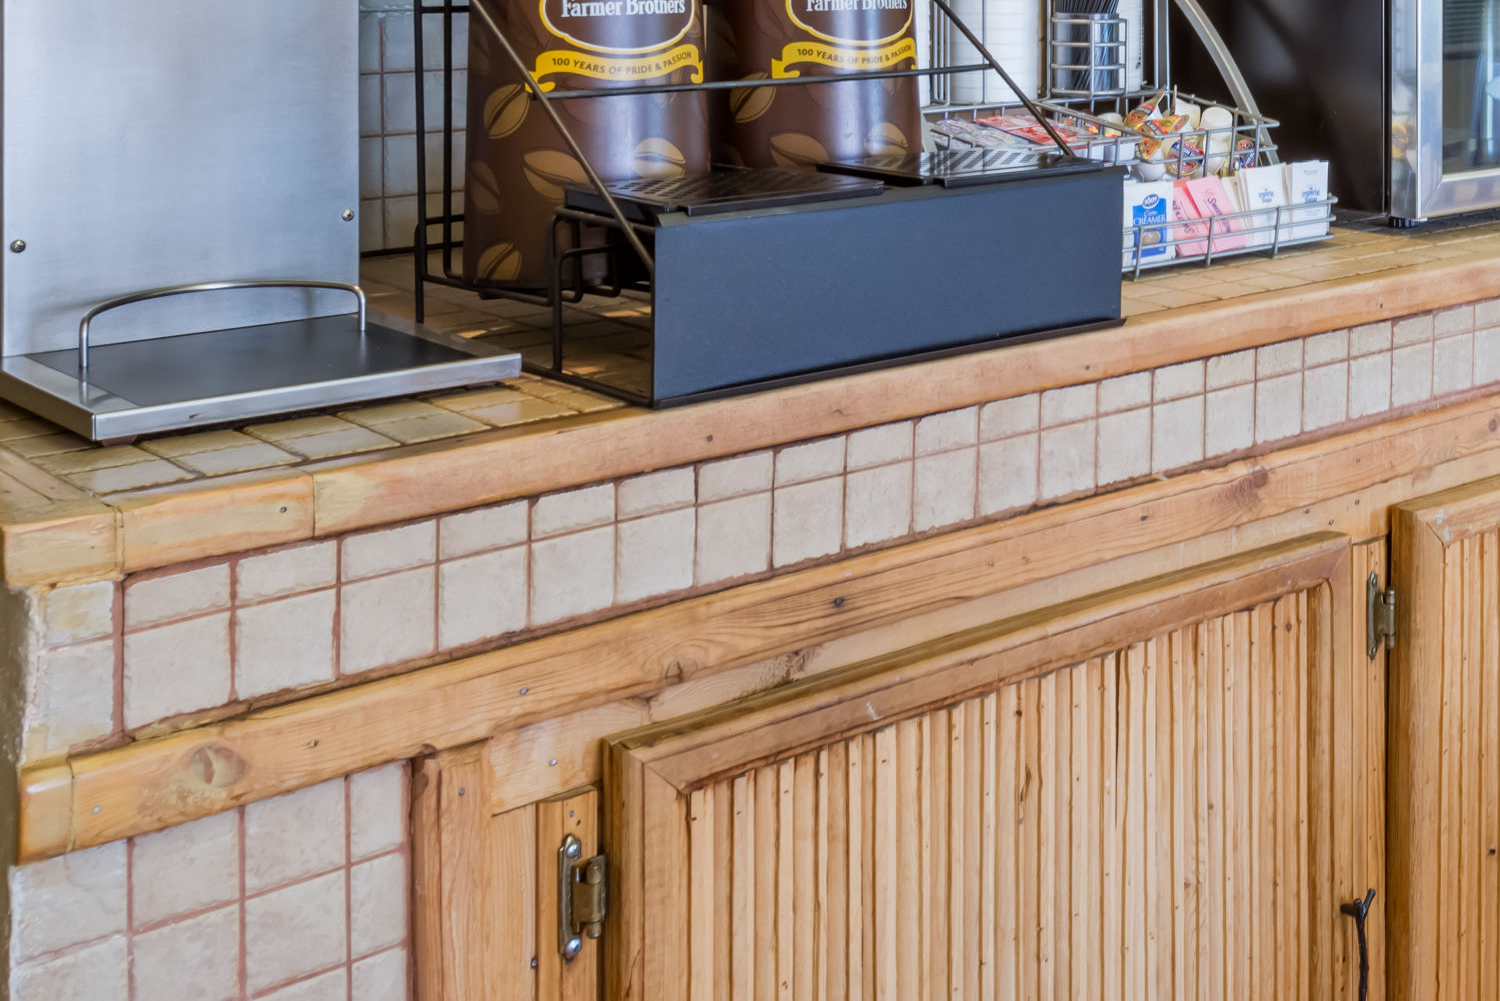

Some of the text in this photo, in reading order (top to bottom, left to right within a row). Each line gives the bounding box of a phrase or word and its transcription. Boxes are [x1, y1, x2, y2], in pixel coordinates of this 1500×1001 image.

[550, 50, 693, 75] 100 YEARS OF PRIDE & PASSION
[797, 45, 913, 65] 100 YEARS OF PRIDE & PASSION
[1133, 214, 1166, 225] CREAMER
